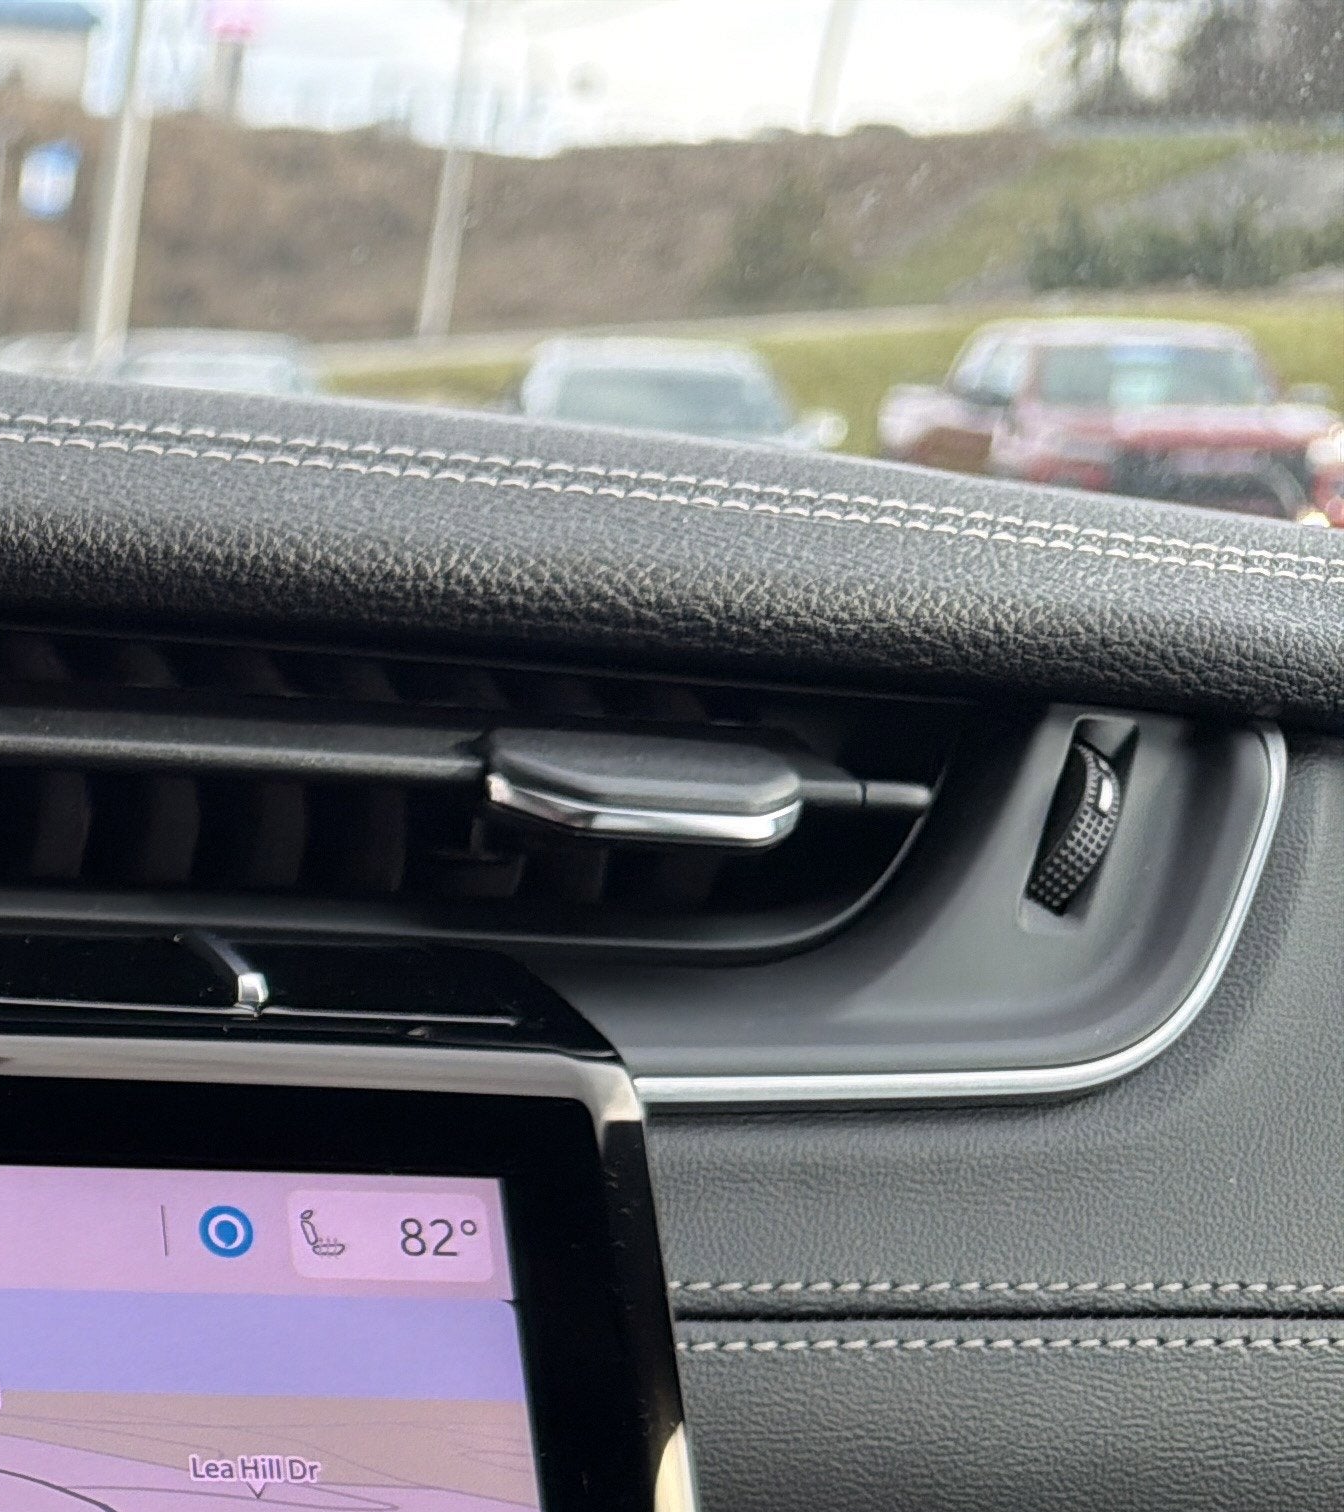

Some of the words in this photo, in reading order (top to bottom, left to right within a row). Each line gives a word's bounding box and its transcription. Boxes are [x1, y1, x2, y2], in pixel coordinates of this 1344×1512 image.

[399, 1217, 479, 1258] 82°
[191, 1457, 235, 1481] Lea
[240, 1457, 282, 1481] Hill
[288, 1458, 319, 1482] Dr
